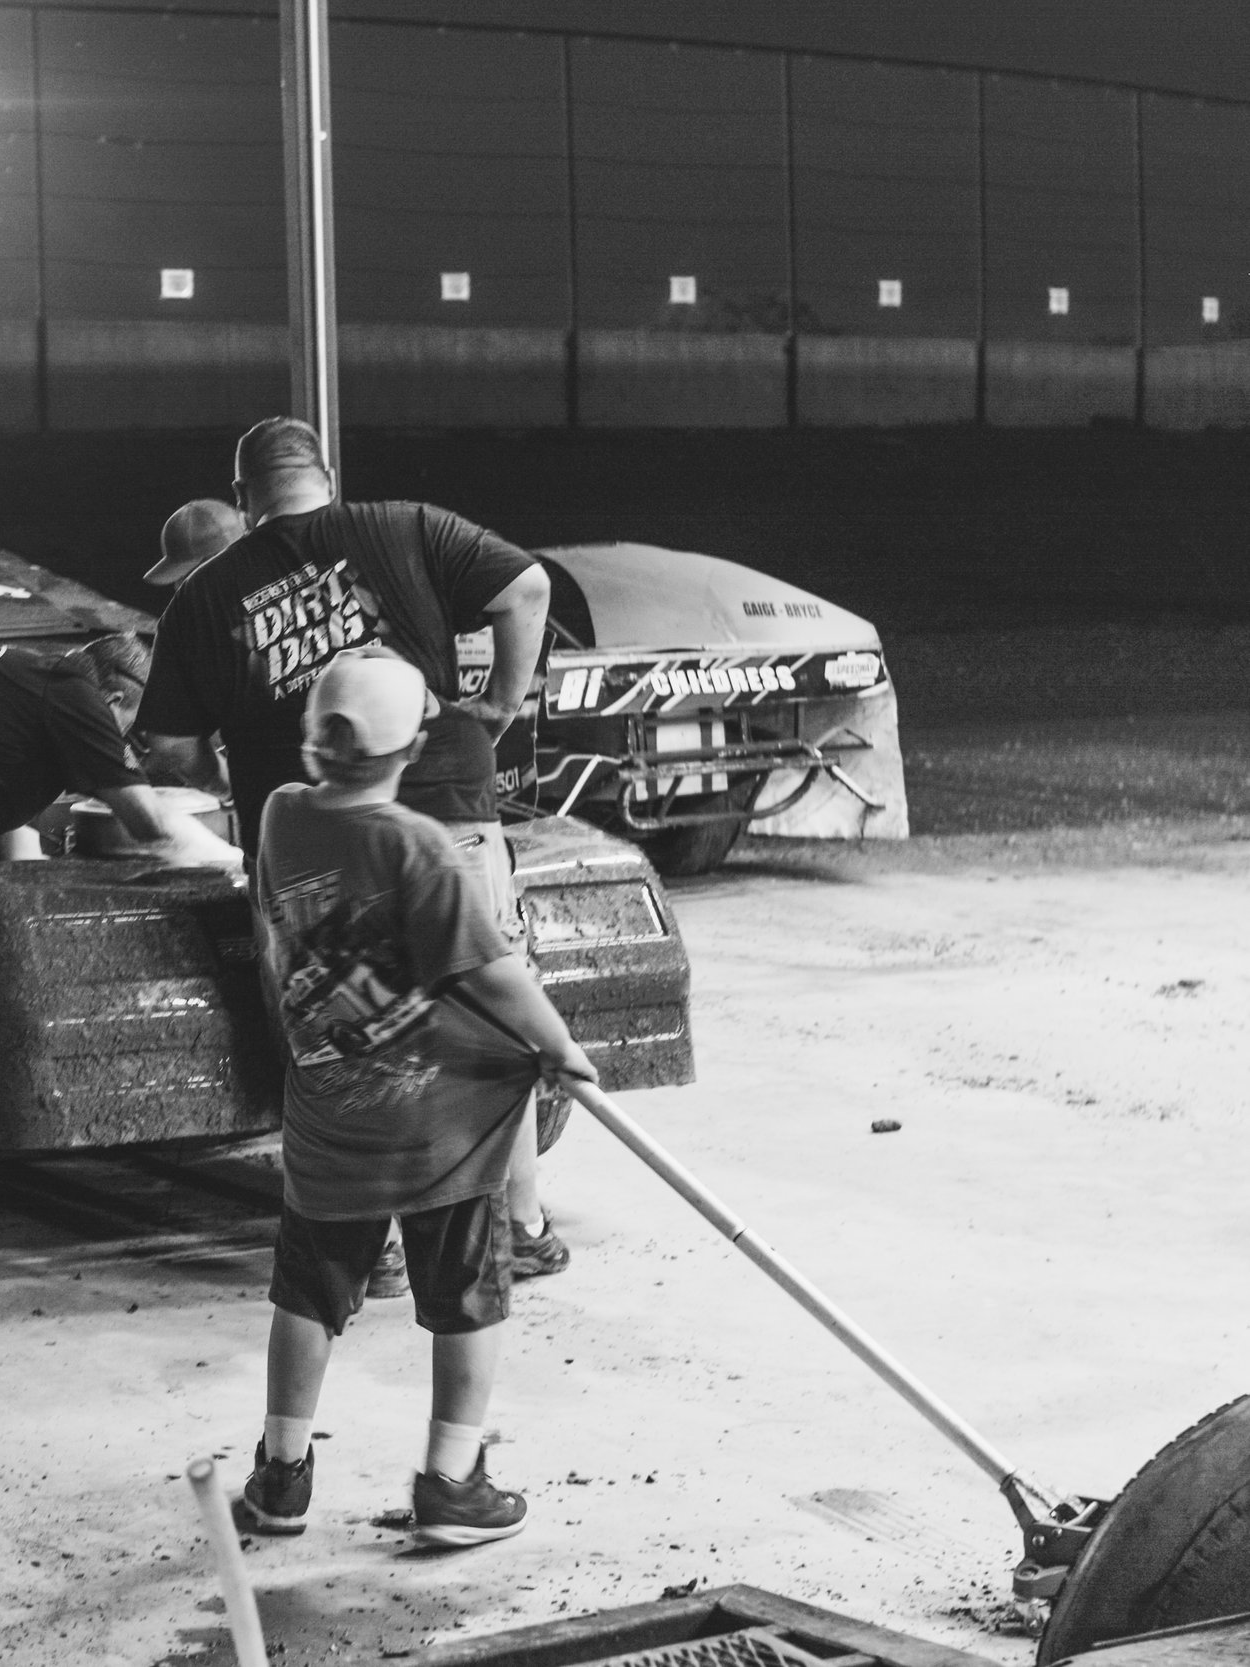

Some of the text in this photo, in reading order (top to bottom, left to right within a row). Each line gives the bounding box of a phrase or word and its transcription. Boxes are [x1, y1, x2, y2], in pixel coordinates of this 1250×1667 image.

[254, 558, 348, 651] DIRT
[742, 601, 778, 618] GAIGE
[784, 602, 824, 619] BRYCE
[268, 599, 365, 685] DOG
[274, 665, 325, 701] A DIFFE
[651, 665, 796, 696] CHILDRESS
